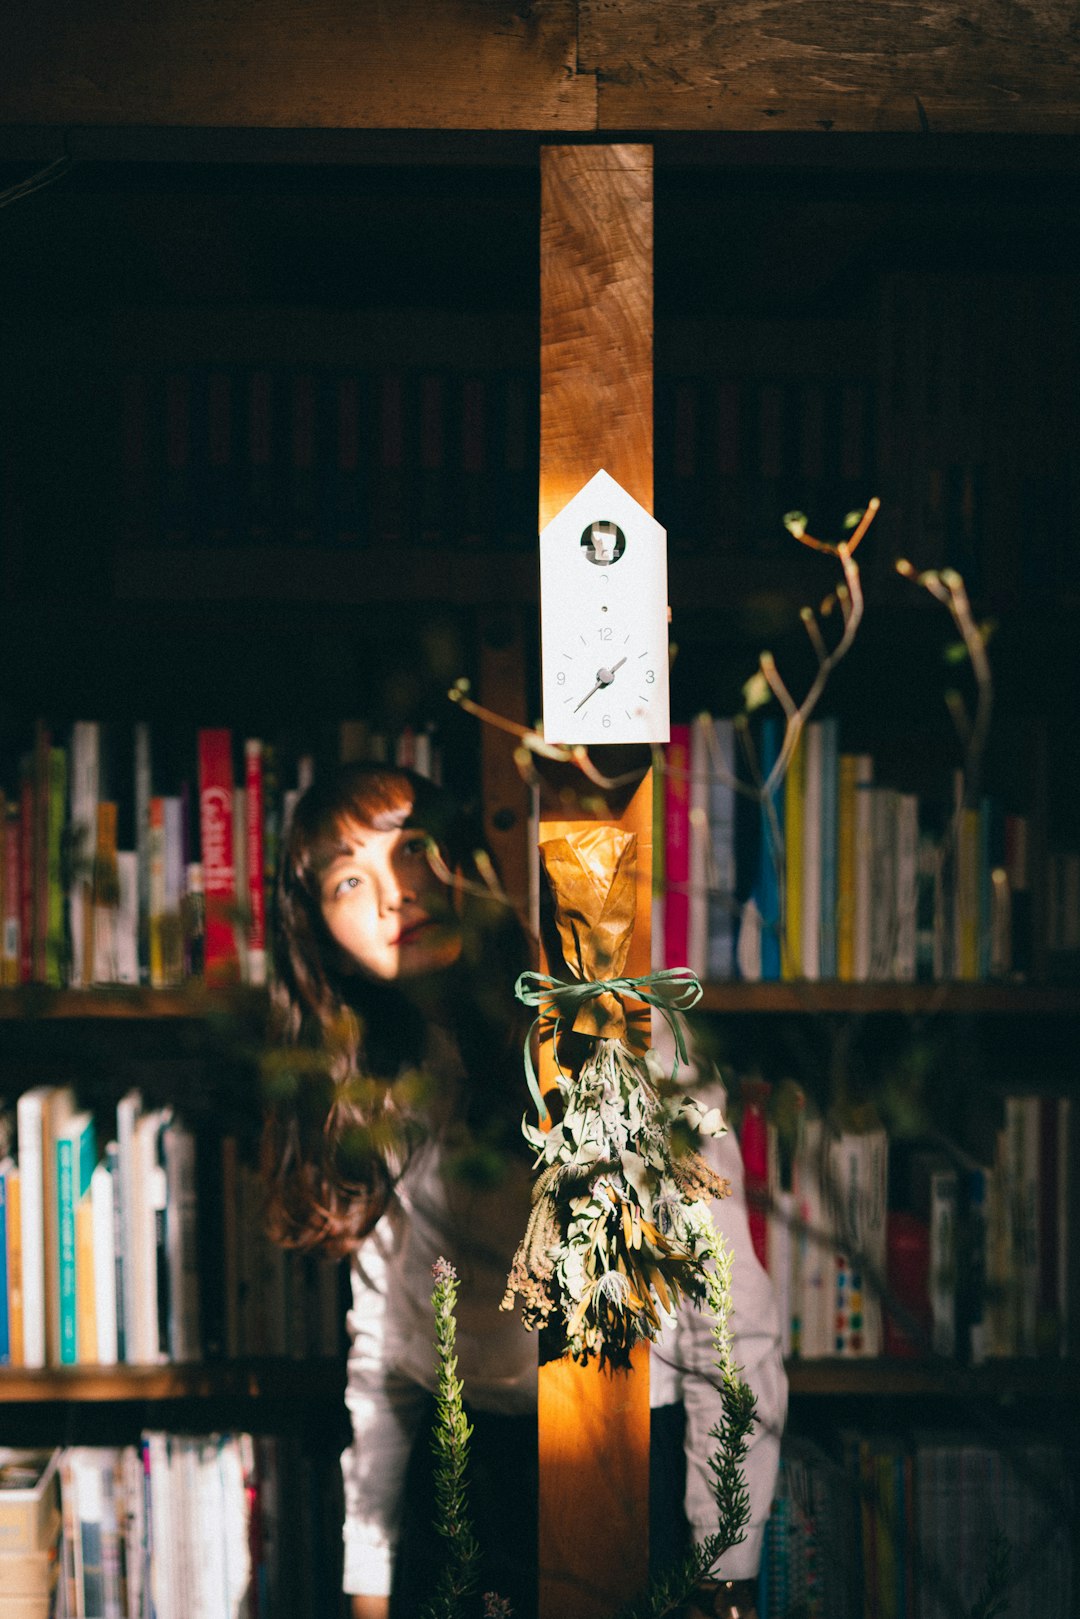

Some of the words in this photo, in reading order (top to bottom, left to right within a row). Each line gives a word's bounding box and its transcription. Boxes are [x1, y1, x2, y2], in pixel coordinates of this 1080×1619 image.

[598, 627, 613, 641] 12
[556, 671, 566, 686] 9
[645, 670, 656, 684] 3
[601, 714, 612, 728] 6
